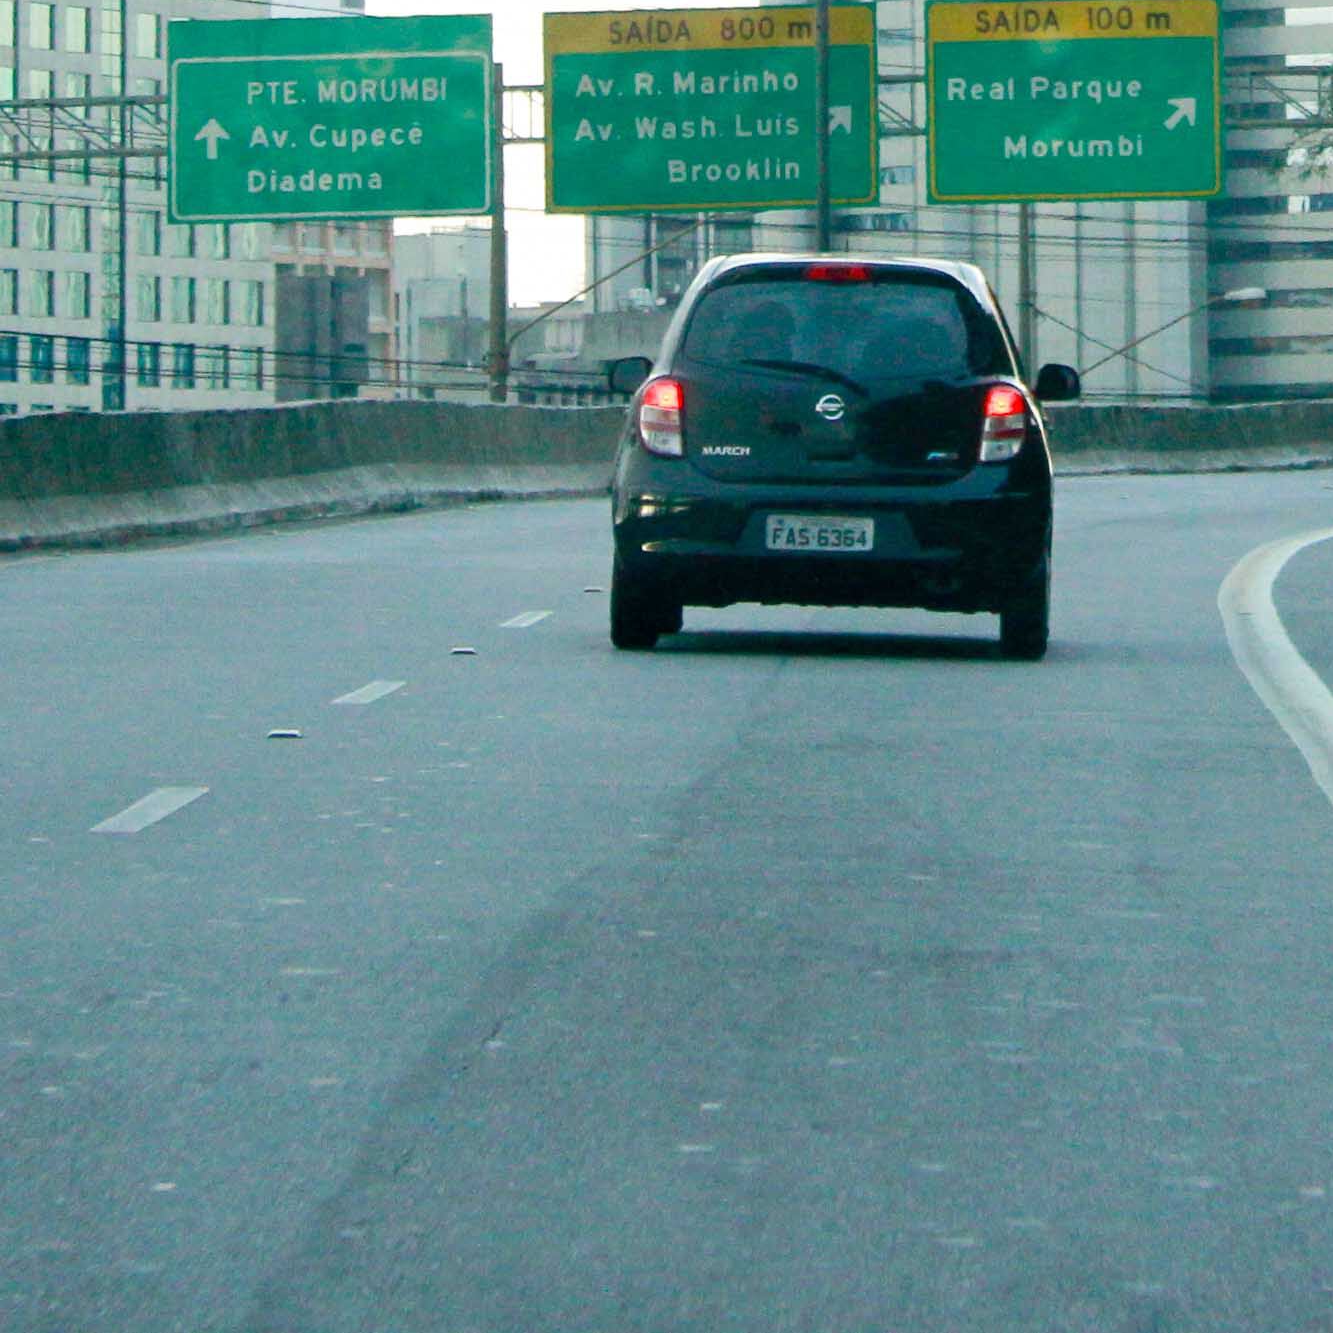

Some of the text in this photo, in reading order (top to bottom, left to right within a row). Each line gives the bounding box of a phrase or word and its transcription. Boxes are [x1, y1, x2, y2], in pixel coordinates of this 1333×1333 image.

[608, 16, 812, 45] SAÍDA 800 m
[975, 4, 1170, 34] SAÍDA 100 m
[247, 78, 447, 105] PTE. MORUMBI
[575, 70, 799, 97] Av. R. Marinho
[947, 76, 1142, 105] Real Parque
[249, 121, 424, 152] Av. Cupecê
[575, 118, 620, 141] Av.
[1004, 135, 1143, 158] Morumbi
[248, 170, 383, 194] Diadema
[668, 159, 799, 183] Brooklin
[701, 445, 750, 456] MARCH
